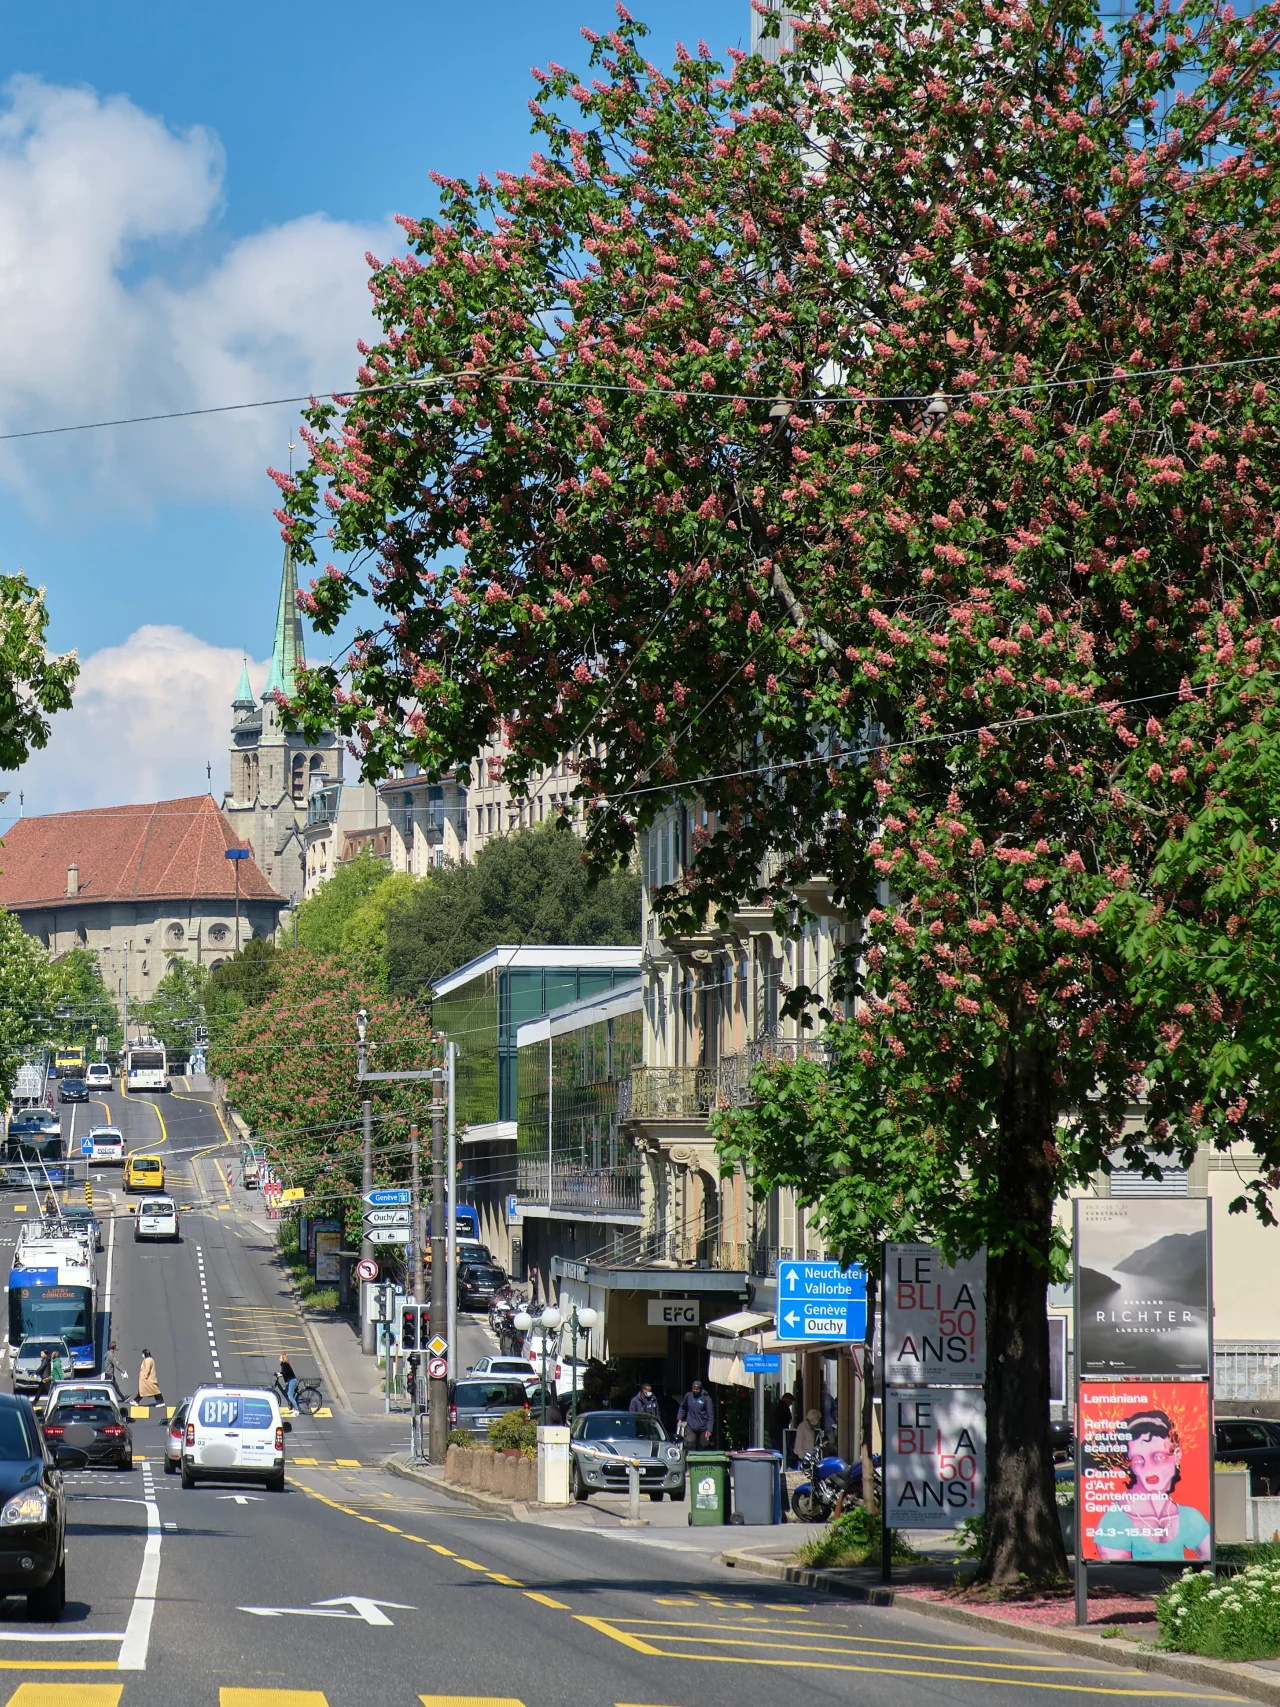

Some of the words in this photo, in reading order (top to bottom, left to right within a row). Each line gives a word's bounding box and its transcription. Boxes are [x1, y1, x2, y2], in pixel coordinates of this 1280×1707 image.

[374, 1213, 395, 1222] Ouchy
[898, 1257, 931, 1284] LE
[22, 1289, 29, 1299] 9
[804, 1282, 852, 1295] Vallorbe
[953, 1284, 977, 1310] A
[663, 1307, 695, 1322] EFG
[804, 1303, 847, 1316] Genève
[1096, 1310, 1192, 1322] RICHTER
[808, 1319, 843, 1334] Ouchy
[939, 1310, 977, 1337] 50
[897, 1336, 975, 1363] ANS!
[1084, 1393, 1148, 1404] Lemaniana
[898, 1402, 931, 1428] LE
[1084, 1418, 1128, 1429] Reflets
[954, 1429, 977, 1454] A
[1084, 1430, 1132, 1441] d'autres
[1084, 1442, 1128, 1453] scènes
[939, 1455, 977, 1481] 50
[1085, 1468, 1126, 1479] Centre
[1085, 1480, 1115, 1490] d'Art
[897, 1481, 975, 1508] ANS!
[1085, 1491, 1169, 1503] Contemporain
[1085, 1502, 1132, 1512] Genève
